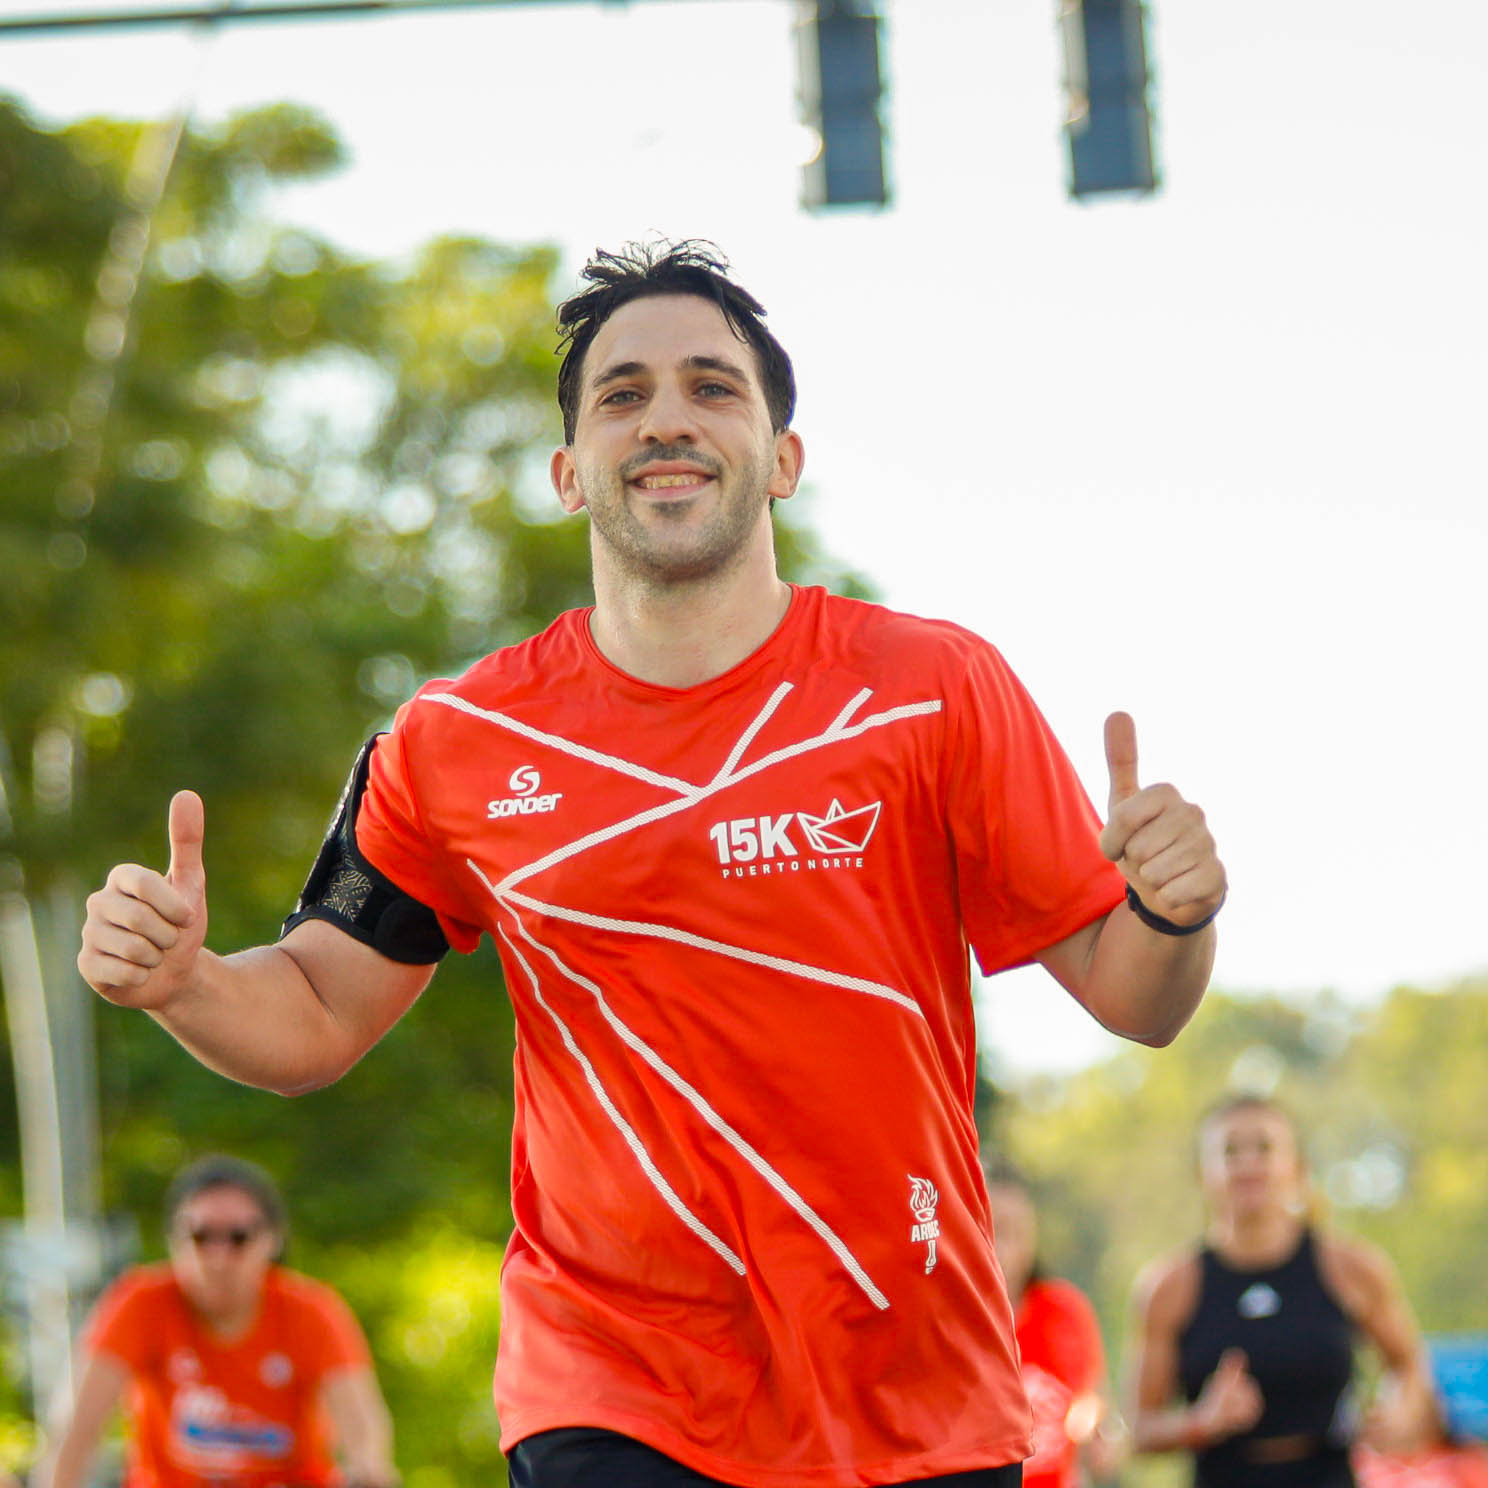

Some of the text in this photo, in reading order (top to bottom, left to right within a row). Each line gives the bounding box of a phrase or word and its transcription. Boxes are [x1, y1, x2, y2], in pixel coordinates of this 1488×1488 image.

[710, 813, 798, 864] 15K
[722, 857, 864, 879] PUERTO NORTE
